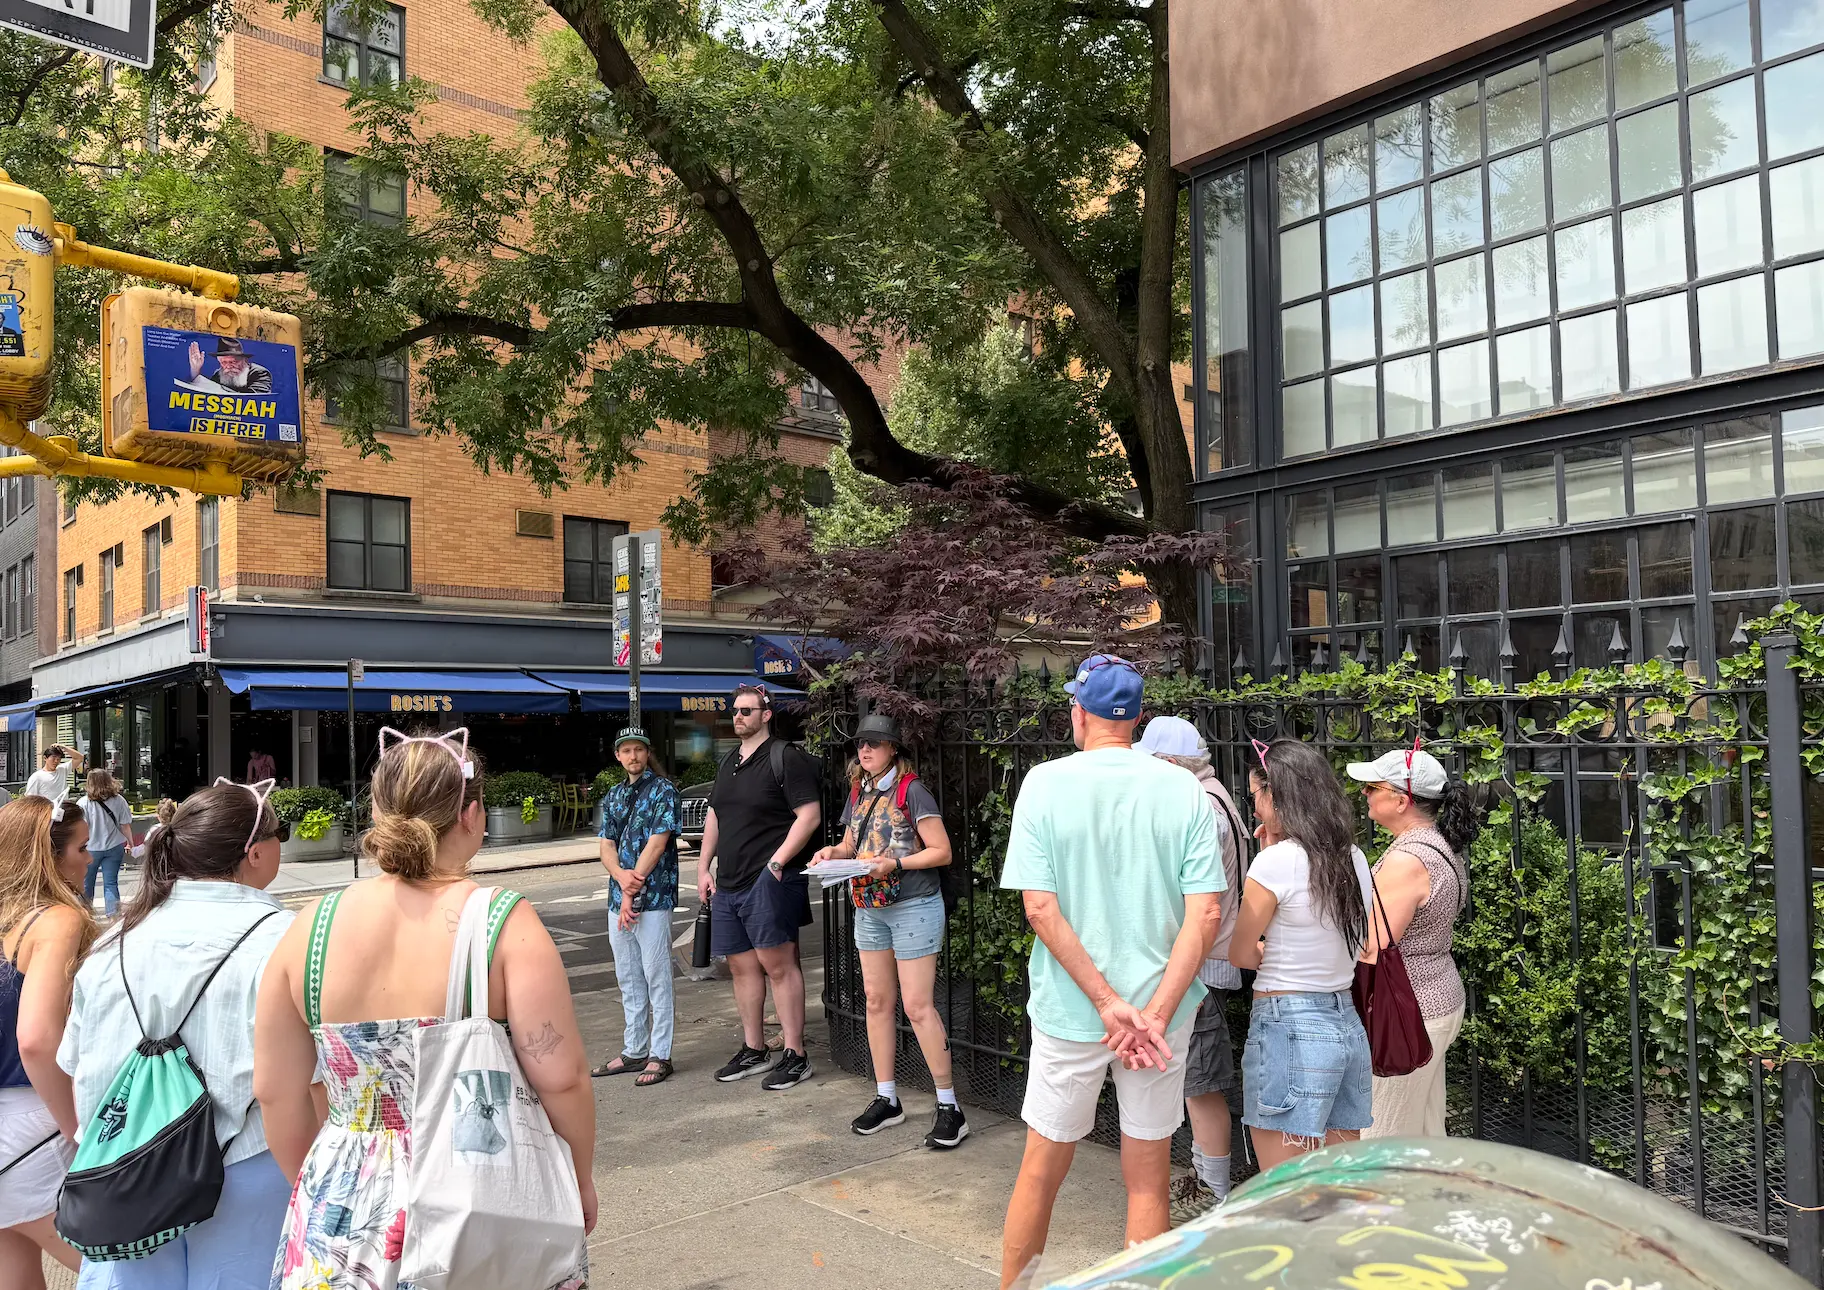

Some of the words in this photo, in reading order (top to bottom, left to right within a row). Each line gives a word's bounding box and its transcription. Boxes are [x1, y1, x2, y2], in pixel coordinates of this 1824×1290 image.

[10, 18, 36, 30] DEPT
[40, 27, 53, 35] OF
[58, 32, 143, 62] TRANSPORTATION
[169, 391, 277, 419] MESSIAH
[192, 418, 208, 432] IS
[213, 420, 265, 438] HERE!
[764, 659, 793, 675] ROSIE'S
[390, 694, 453, 712] ROSIE'S
[681, 696, 727, 712] ROSIE'S
